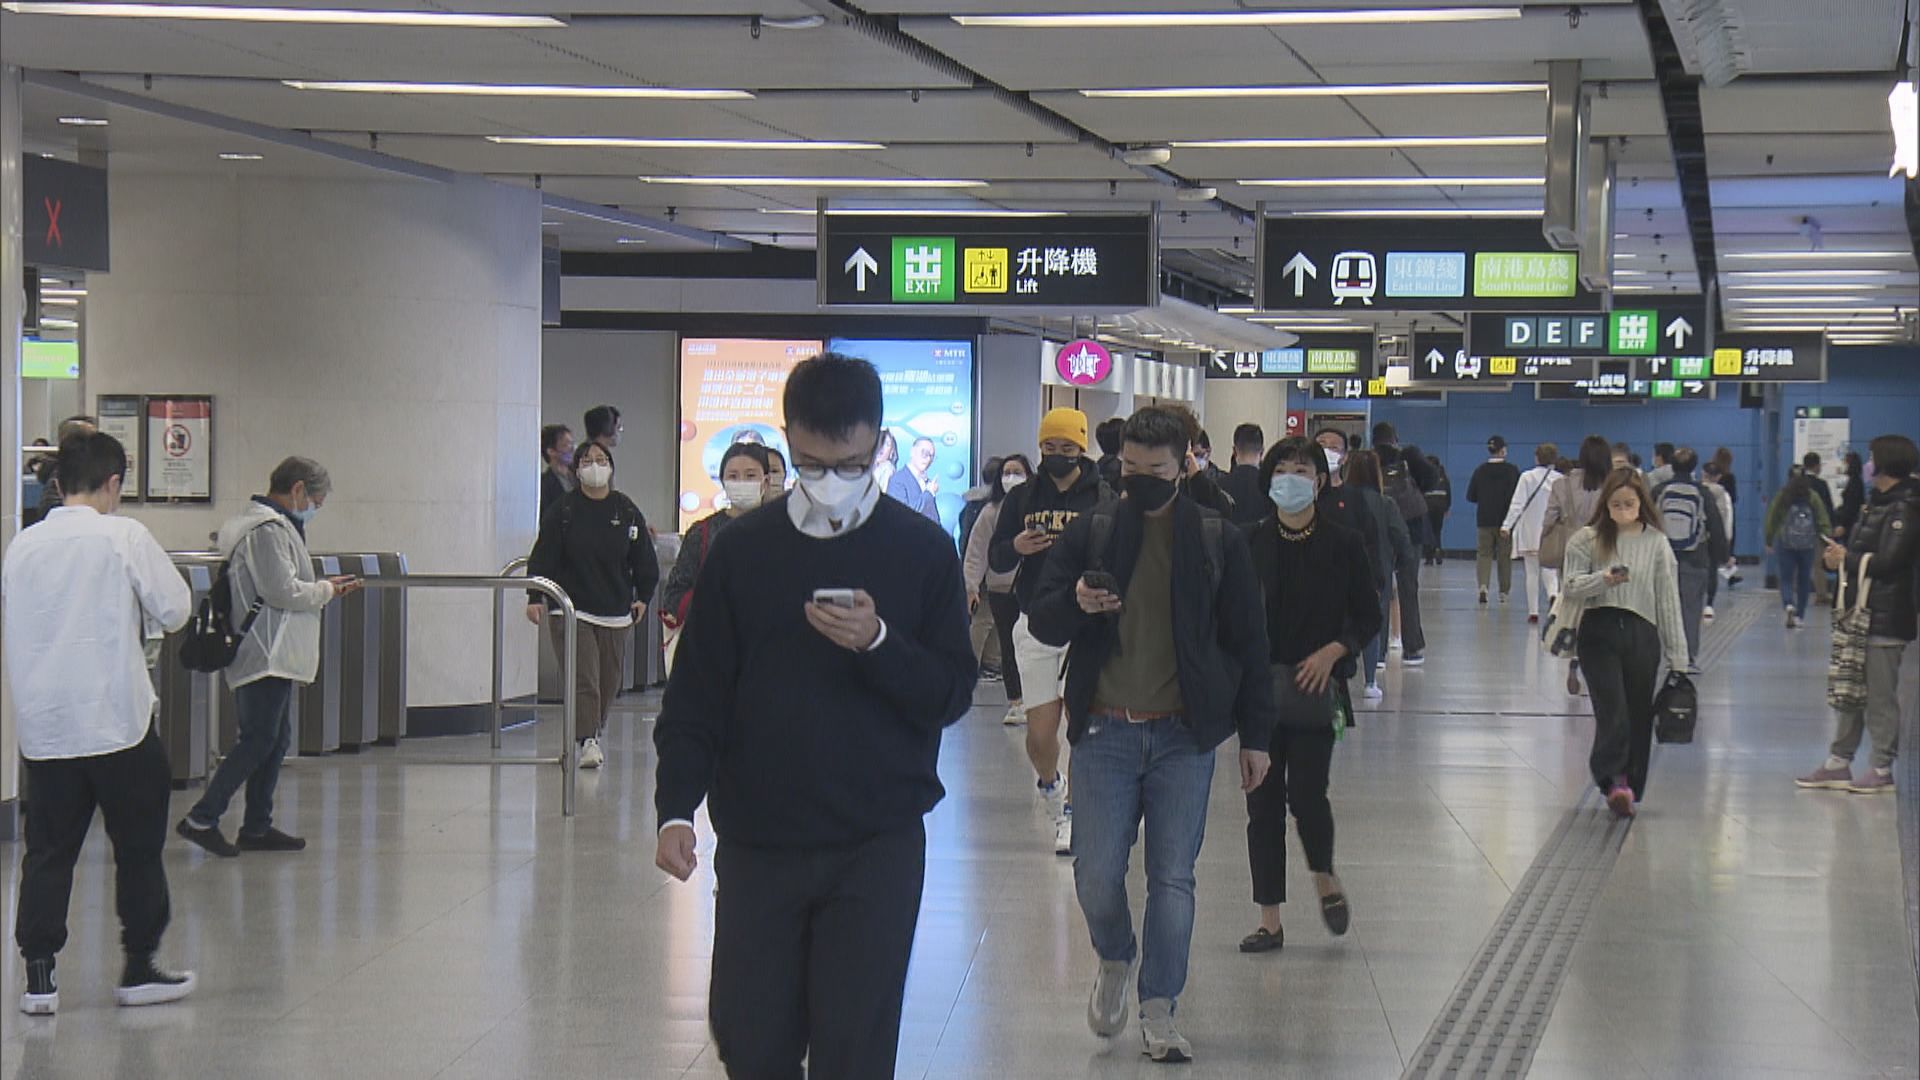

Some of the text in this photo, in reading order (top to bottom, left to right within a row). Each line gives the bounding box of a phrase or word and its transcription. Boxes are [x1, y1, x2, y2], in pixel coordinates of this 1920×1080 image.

[905, 245, 941, 281] 出
[1016, 247, 1098, 276] 升降機
[905, 280, 940, 294] EXIT
[1016, 279, 1039, 294] Lift
[1392, 281, 1457, 292] East Rail Line
[1480, 281, 1569, 292] South Island Line
[1511, 322, 1594, 343] D E F
[1618, 339, 1647, 350] EXIT
